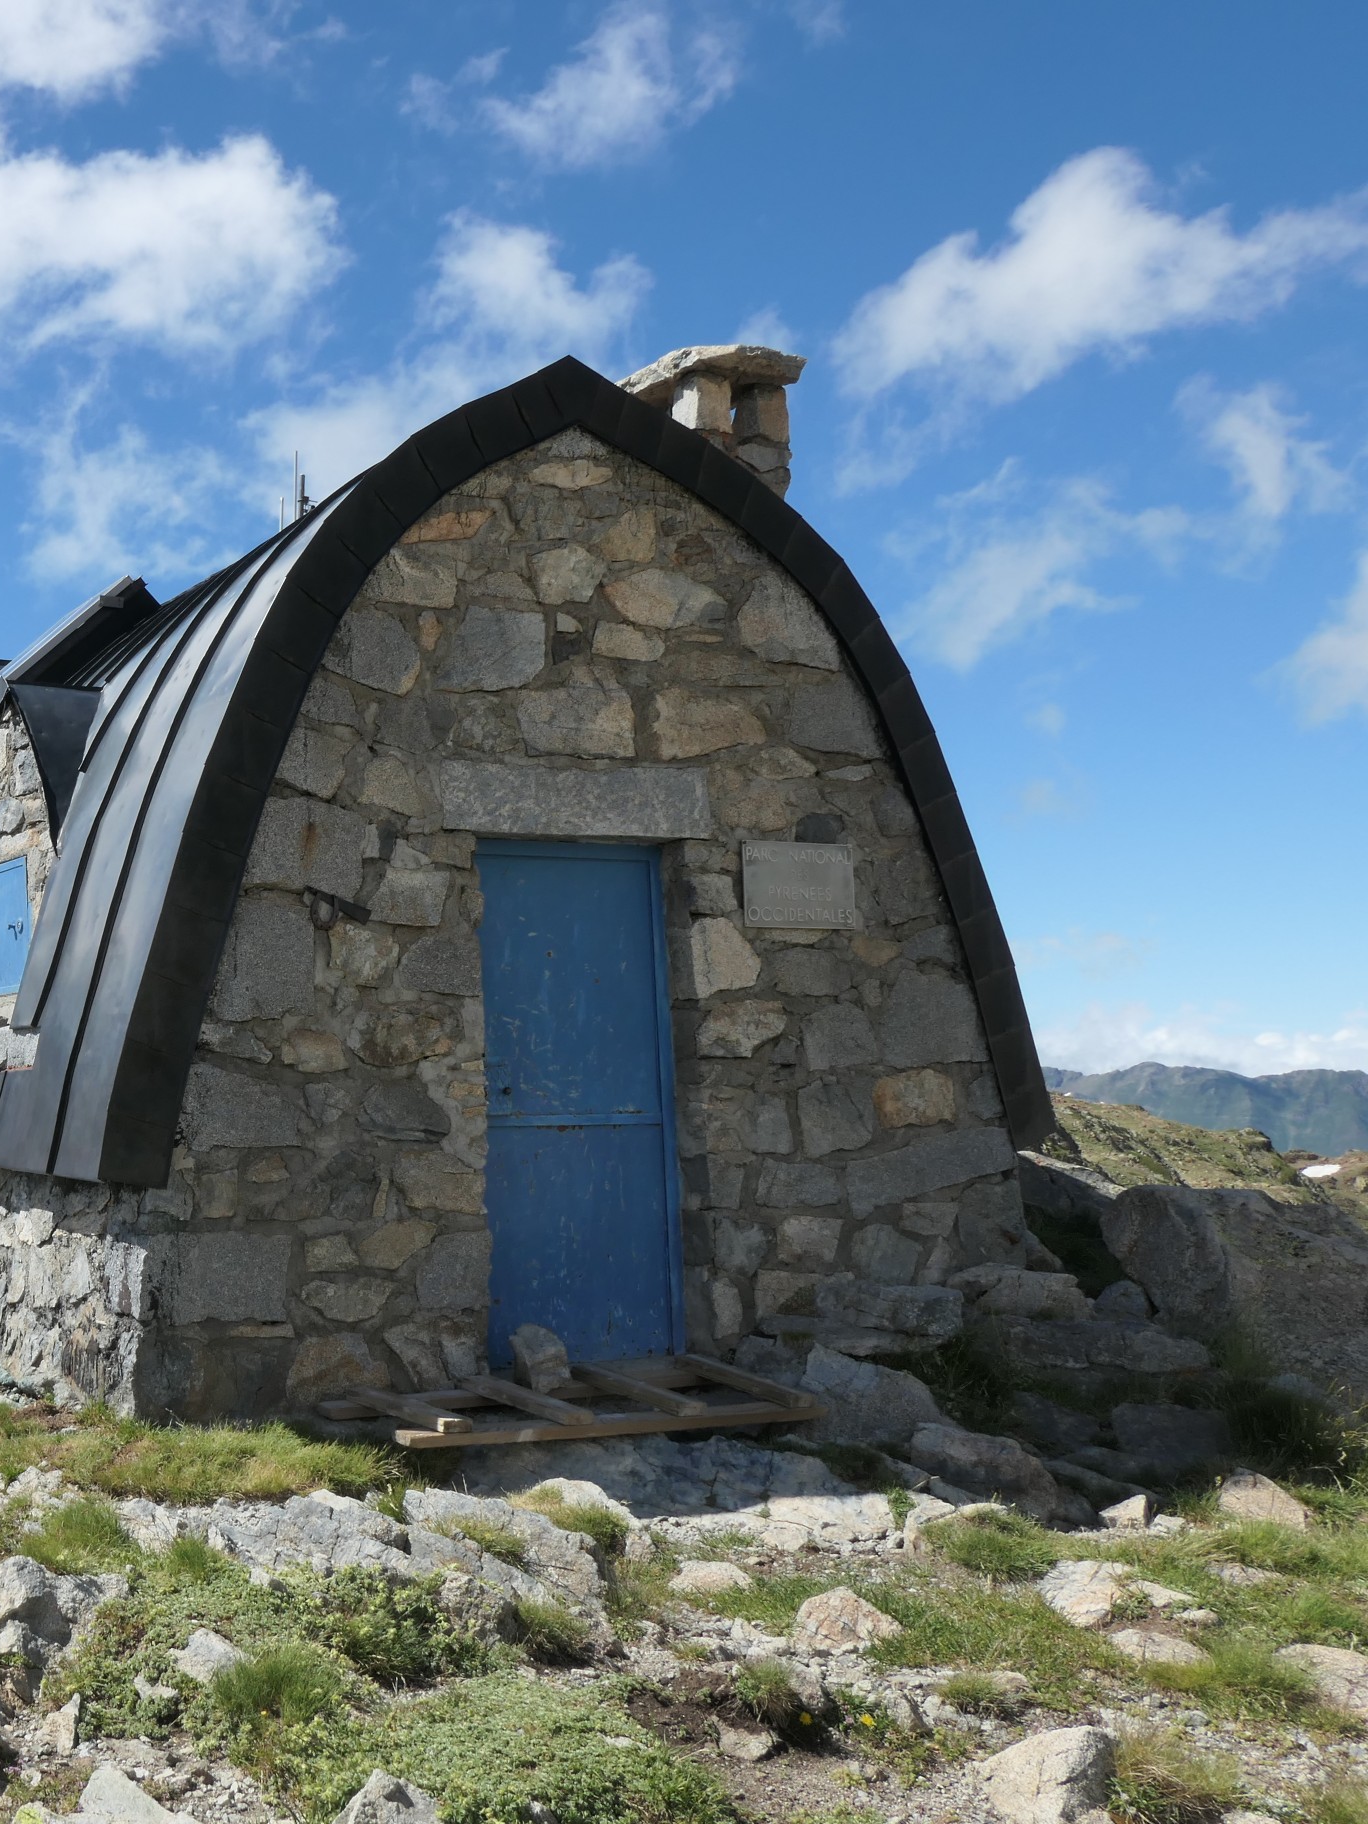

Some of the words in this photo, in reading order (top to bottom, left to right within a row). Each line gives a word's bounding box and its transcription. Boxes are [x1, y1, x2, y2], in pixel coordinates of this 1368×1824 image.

[745, 846, 778, 862] PARC
[789, 848, 851, 865] NATIONAL
[791, 868, 809, 881] DES
[748, 906, 853, 923] OCCIDENTALES
